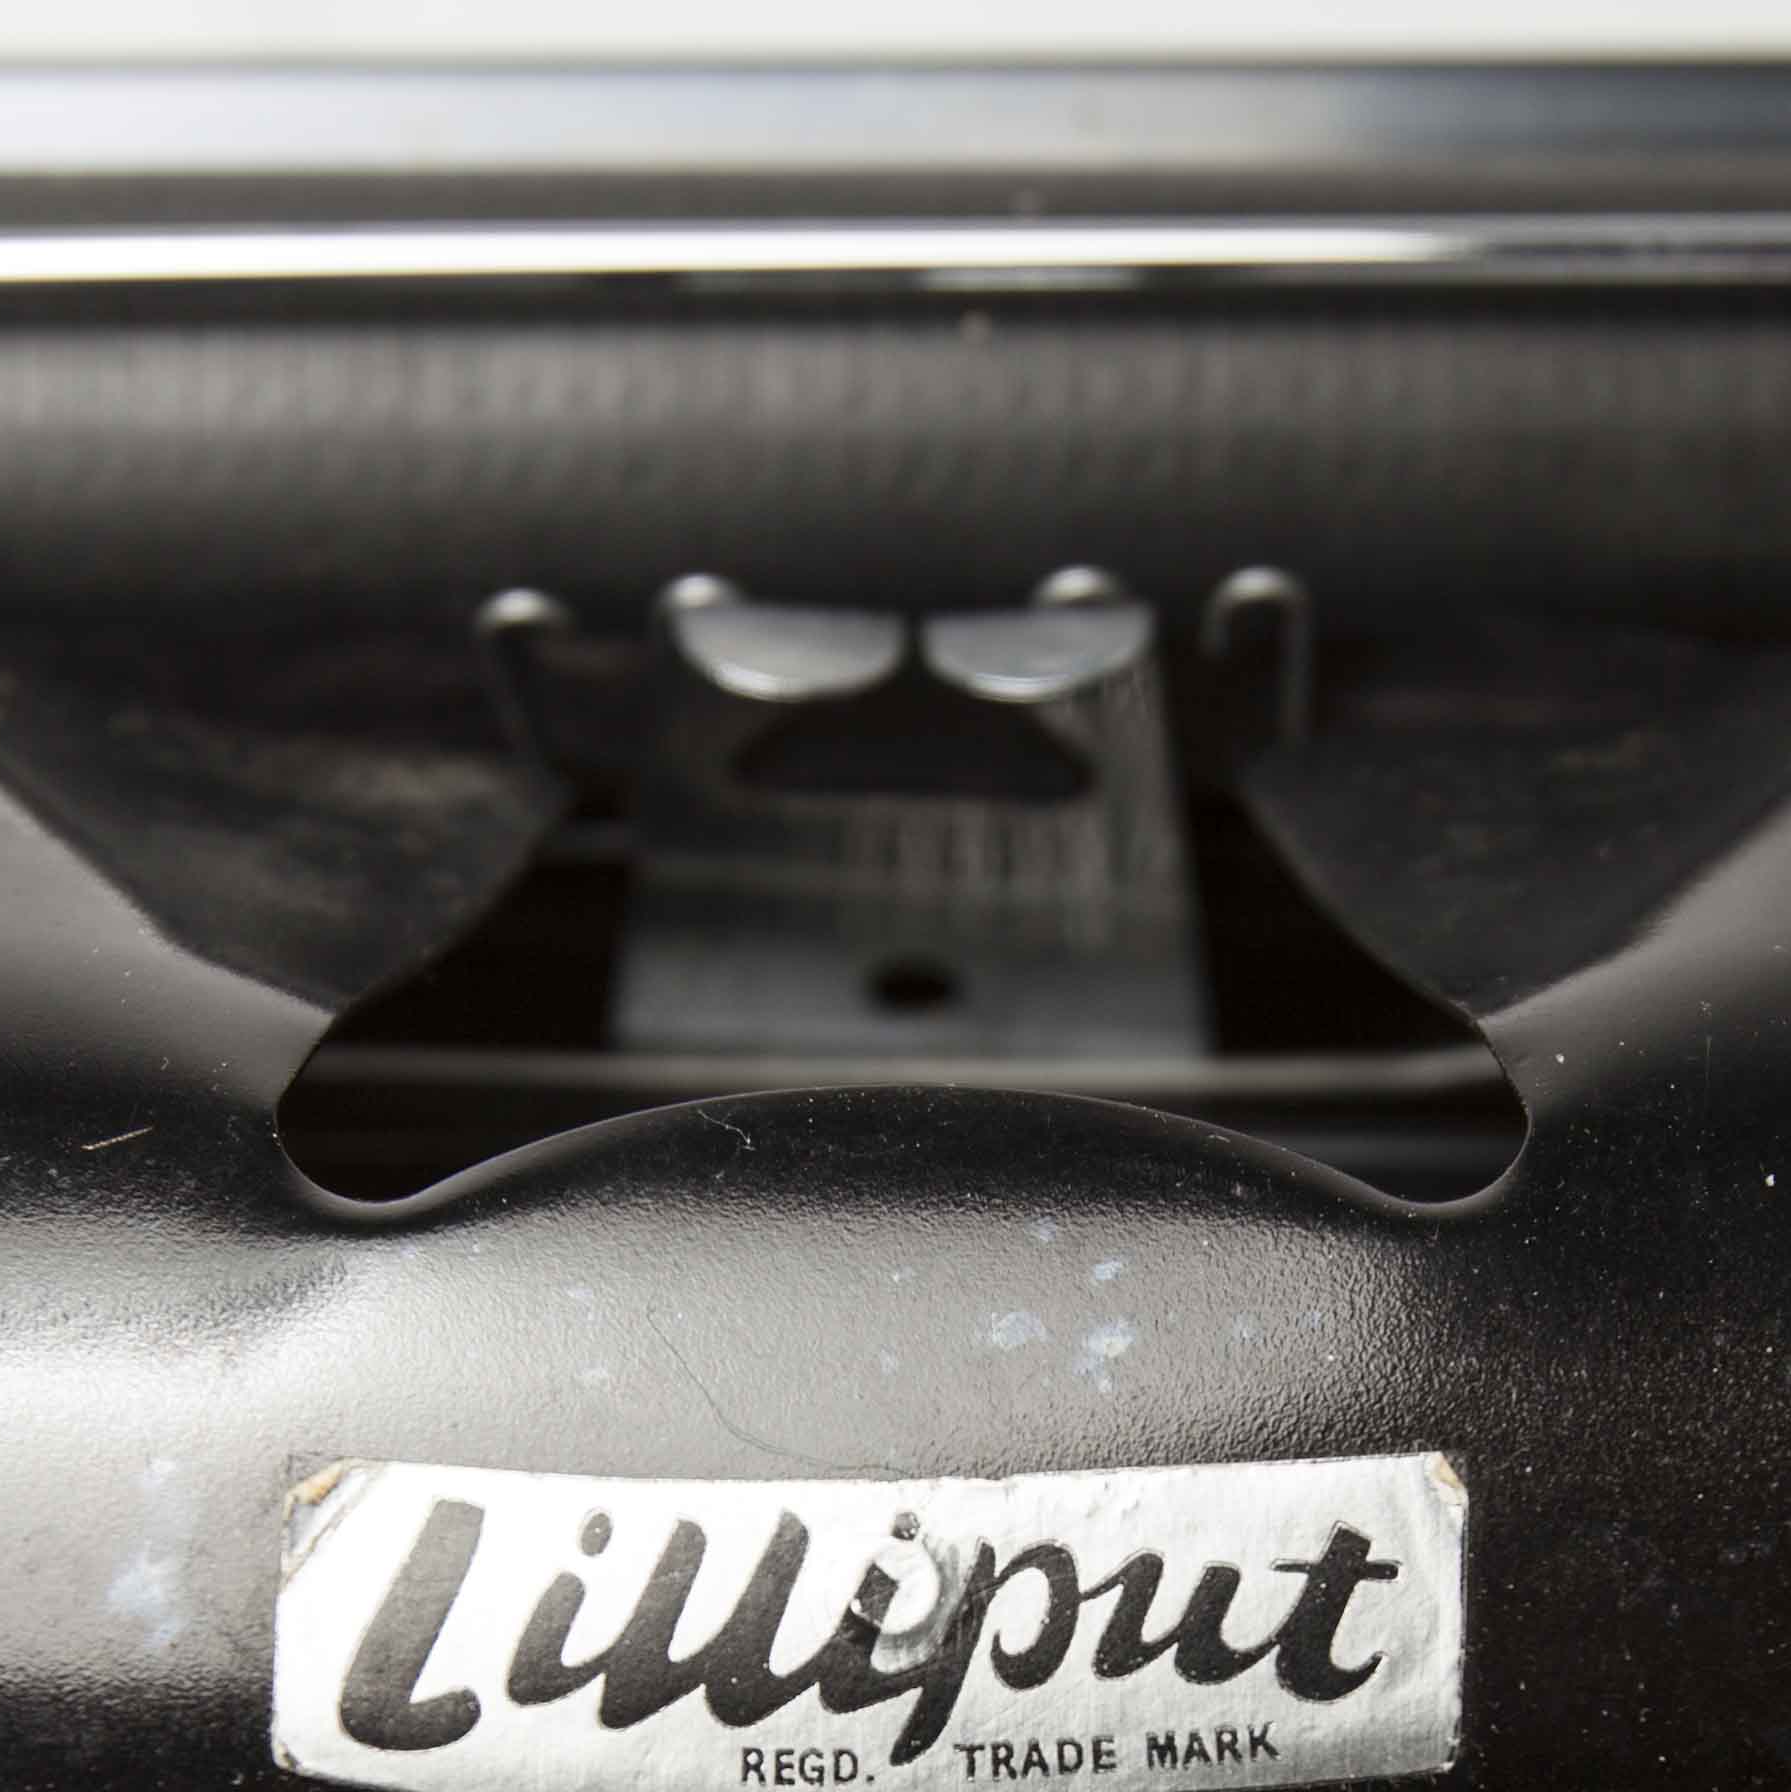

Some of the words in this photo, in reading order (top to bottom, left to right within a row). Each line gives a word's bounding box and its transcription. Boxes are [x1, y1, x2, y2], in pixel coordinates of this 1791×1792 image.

[338, 1496, 1402, 1768] Lilliput
[740, 1746, 876, 1787] REGD.
[953, 1735, 1119, 1783] TRADE
[1145, 1720, 1281, 1771] MARK
